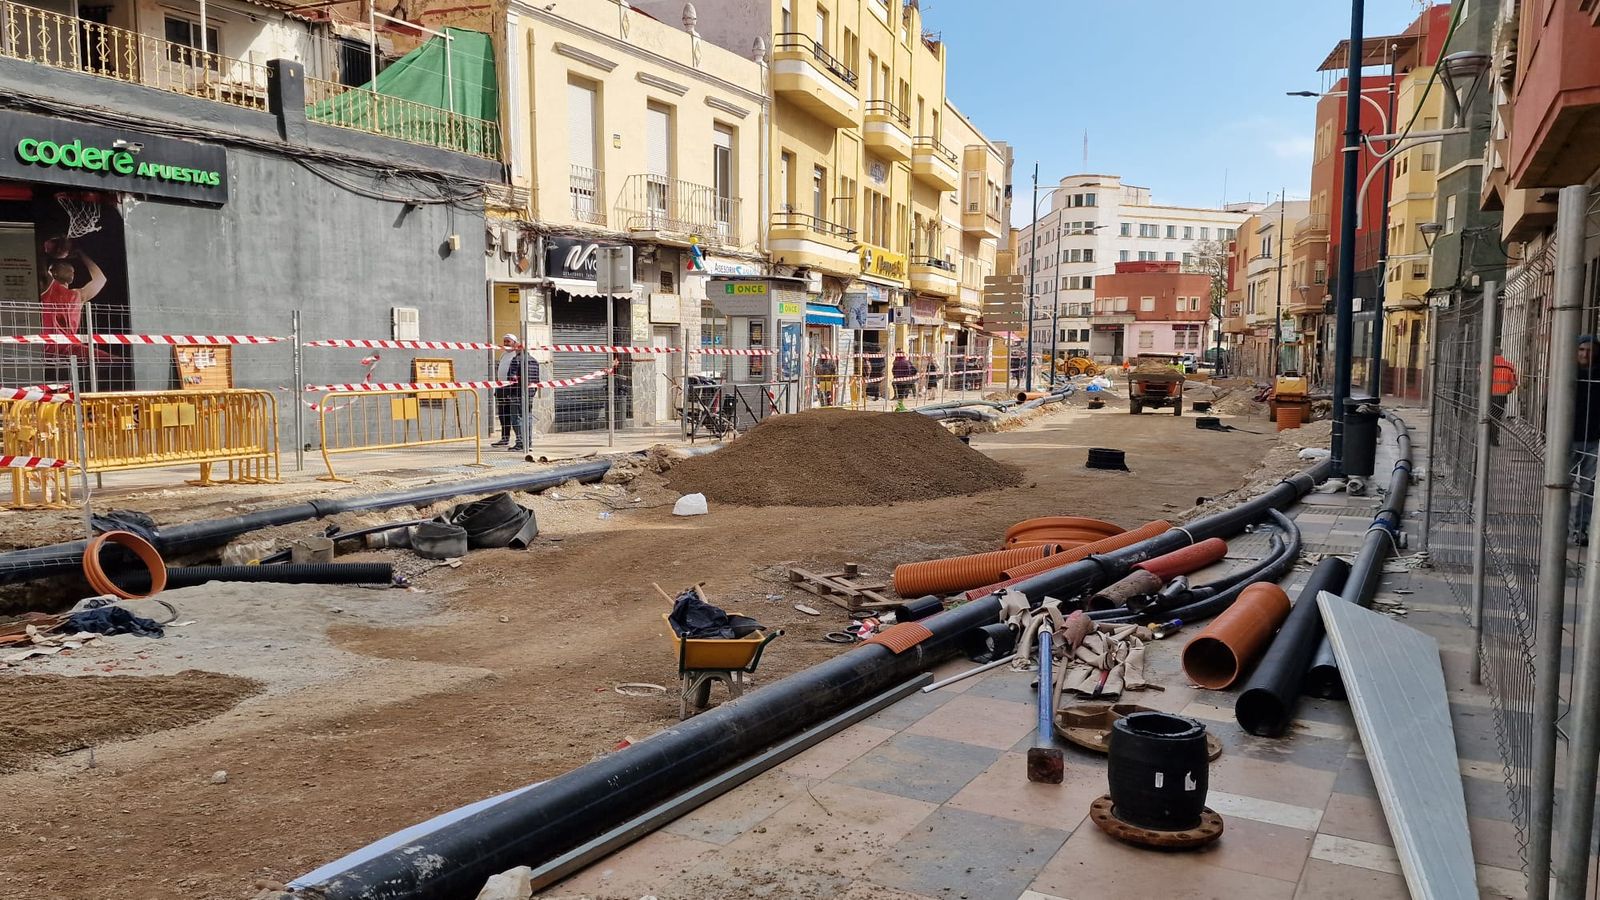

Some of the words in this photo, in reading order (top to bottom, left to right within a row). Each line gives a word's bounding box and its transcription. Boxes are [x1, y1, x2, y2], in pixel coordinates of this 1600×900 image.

[18, 138, 134, 174] codere
[137, 162, 221, 186] APUESTAS
[737, 285, 763, 293] ONCE
[784, 304, 797, 314] ONCE
